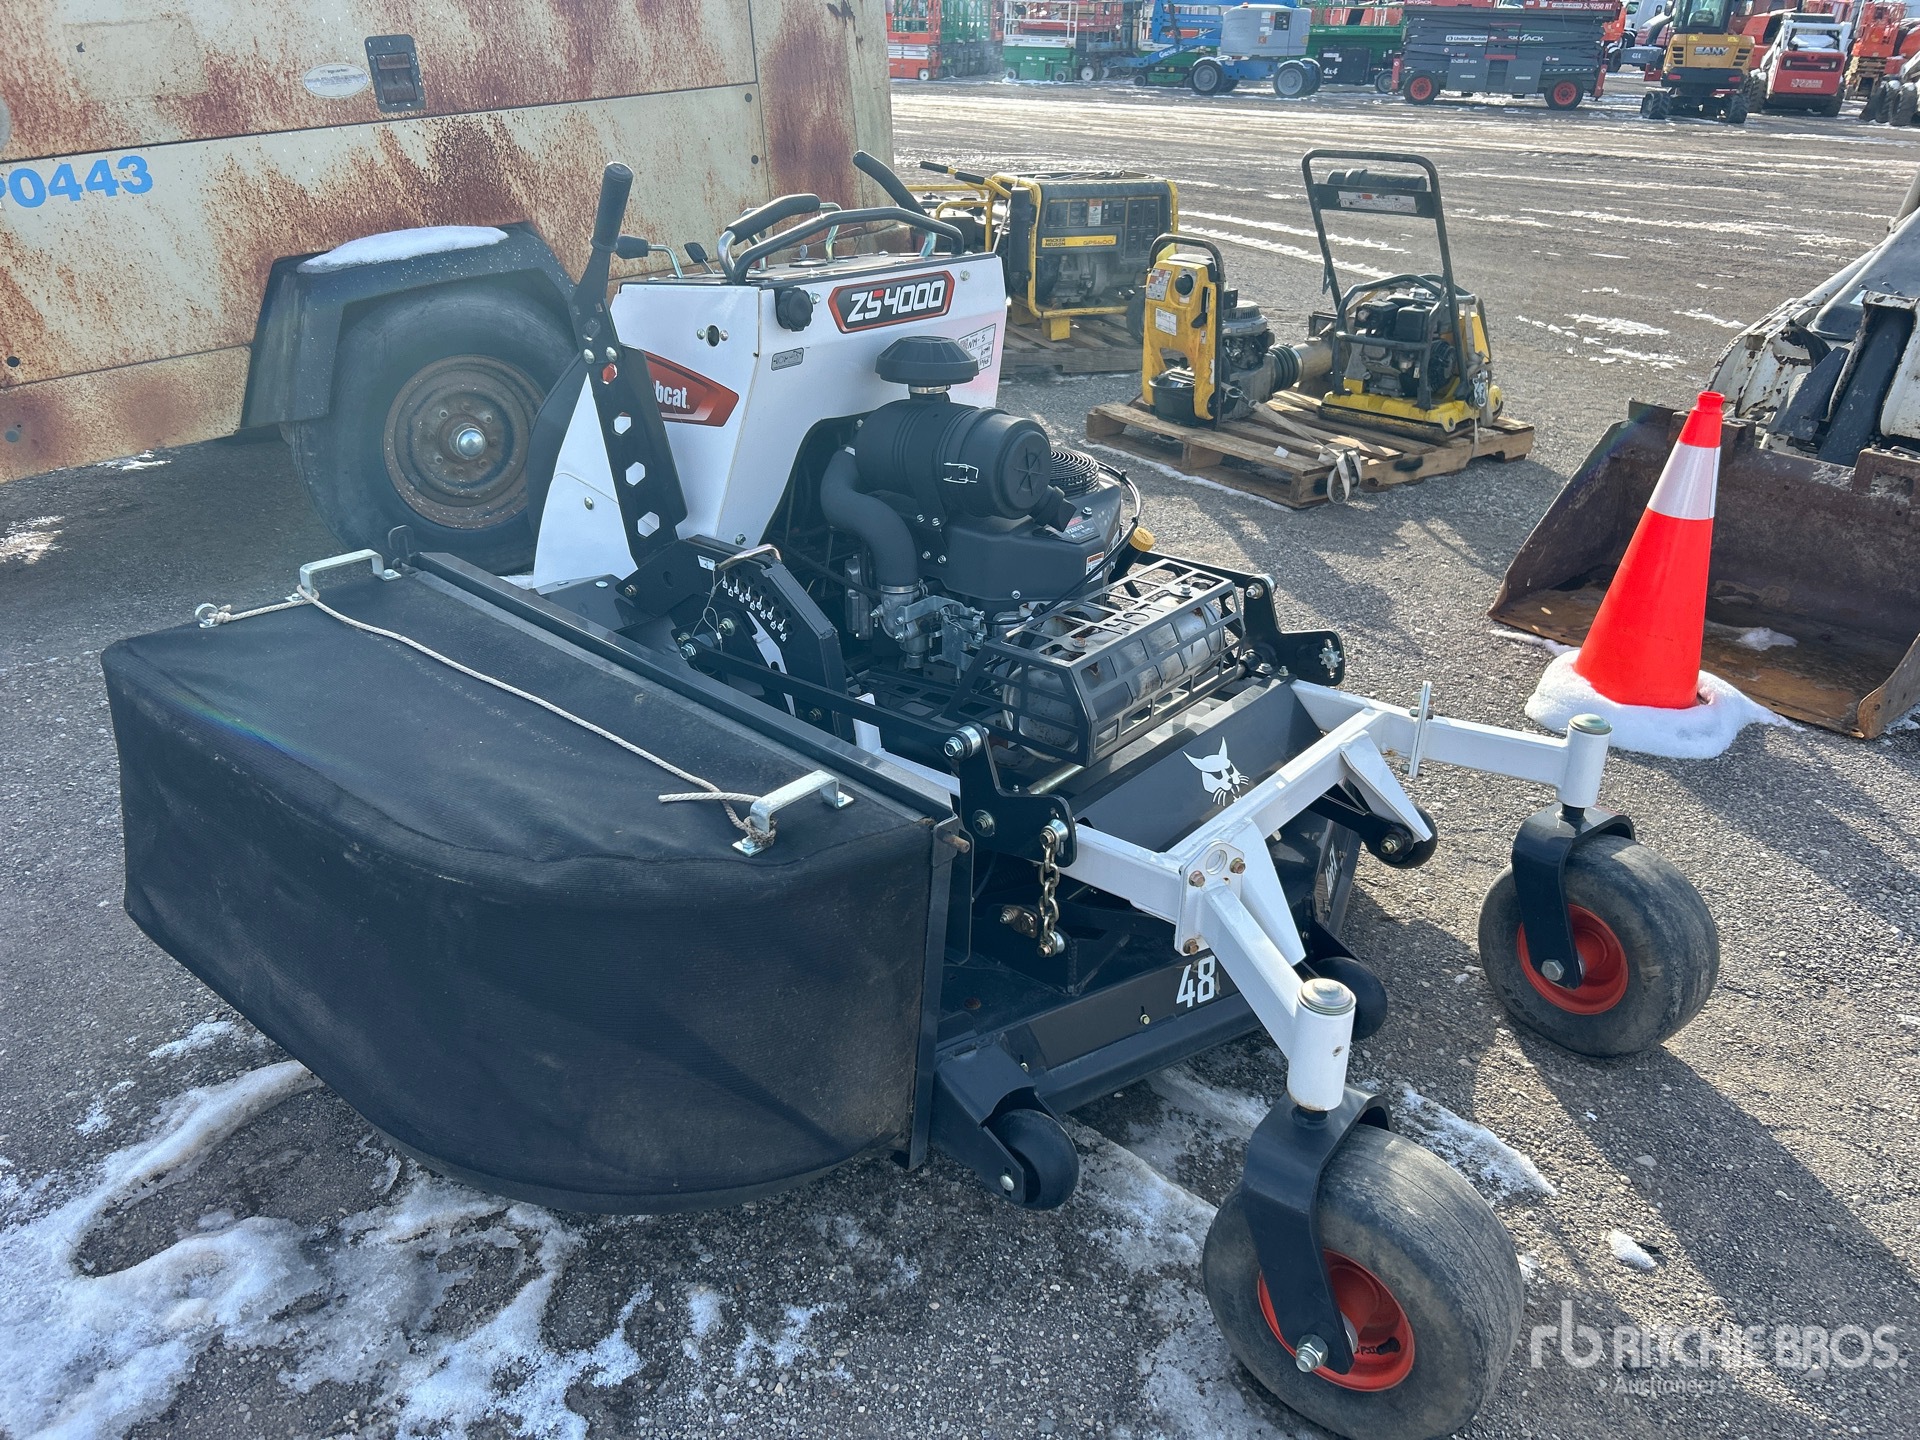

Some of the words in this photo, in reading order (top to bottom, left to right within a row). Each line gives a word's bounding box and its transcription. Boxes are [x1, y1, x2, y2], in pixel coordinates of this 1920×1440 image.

[1508, 34, 1544, 42] SKYJACK
[1694, 46, 1729, 55] SANY
[0, 155, 153, 208] 0443
[847, 280, 945, 322] ZS4000
[1176, 955, 1215, 1008] 48
